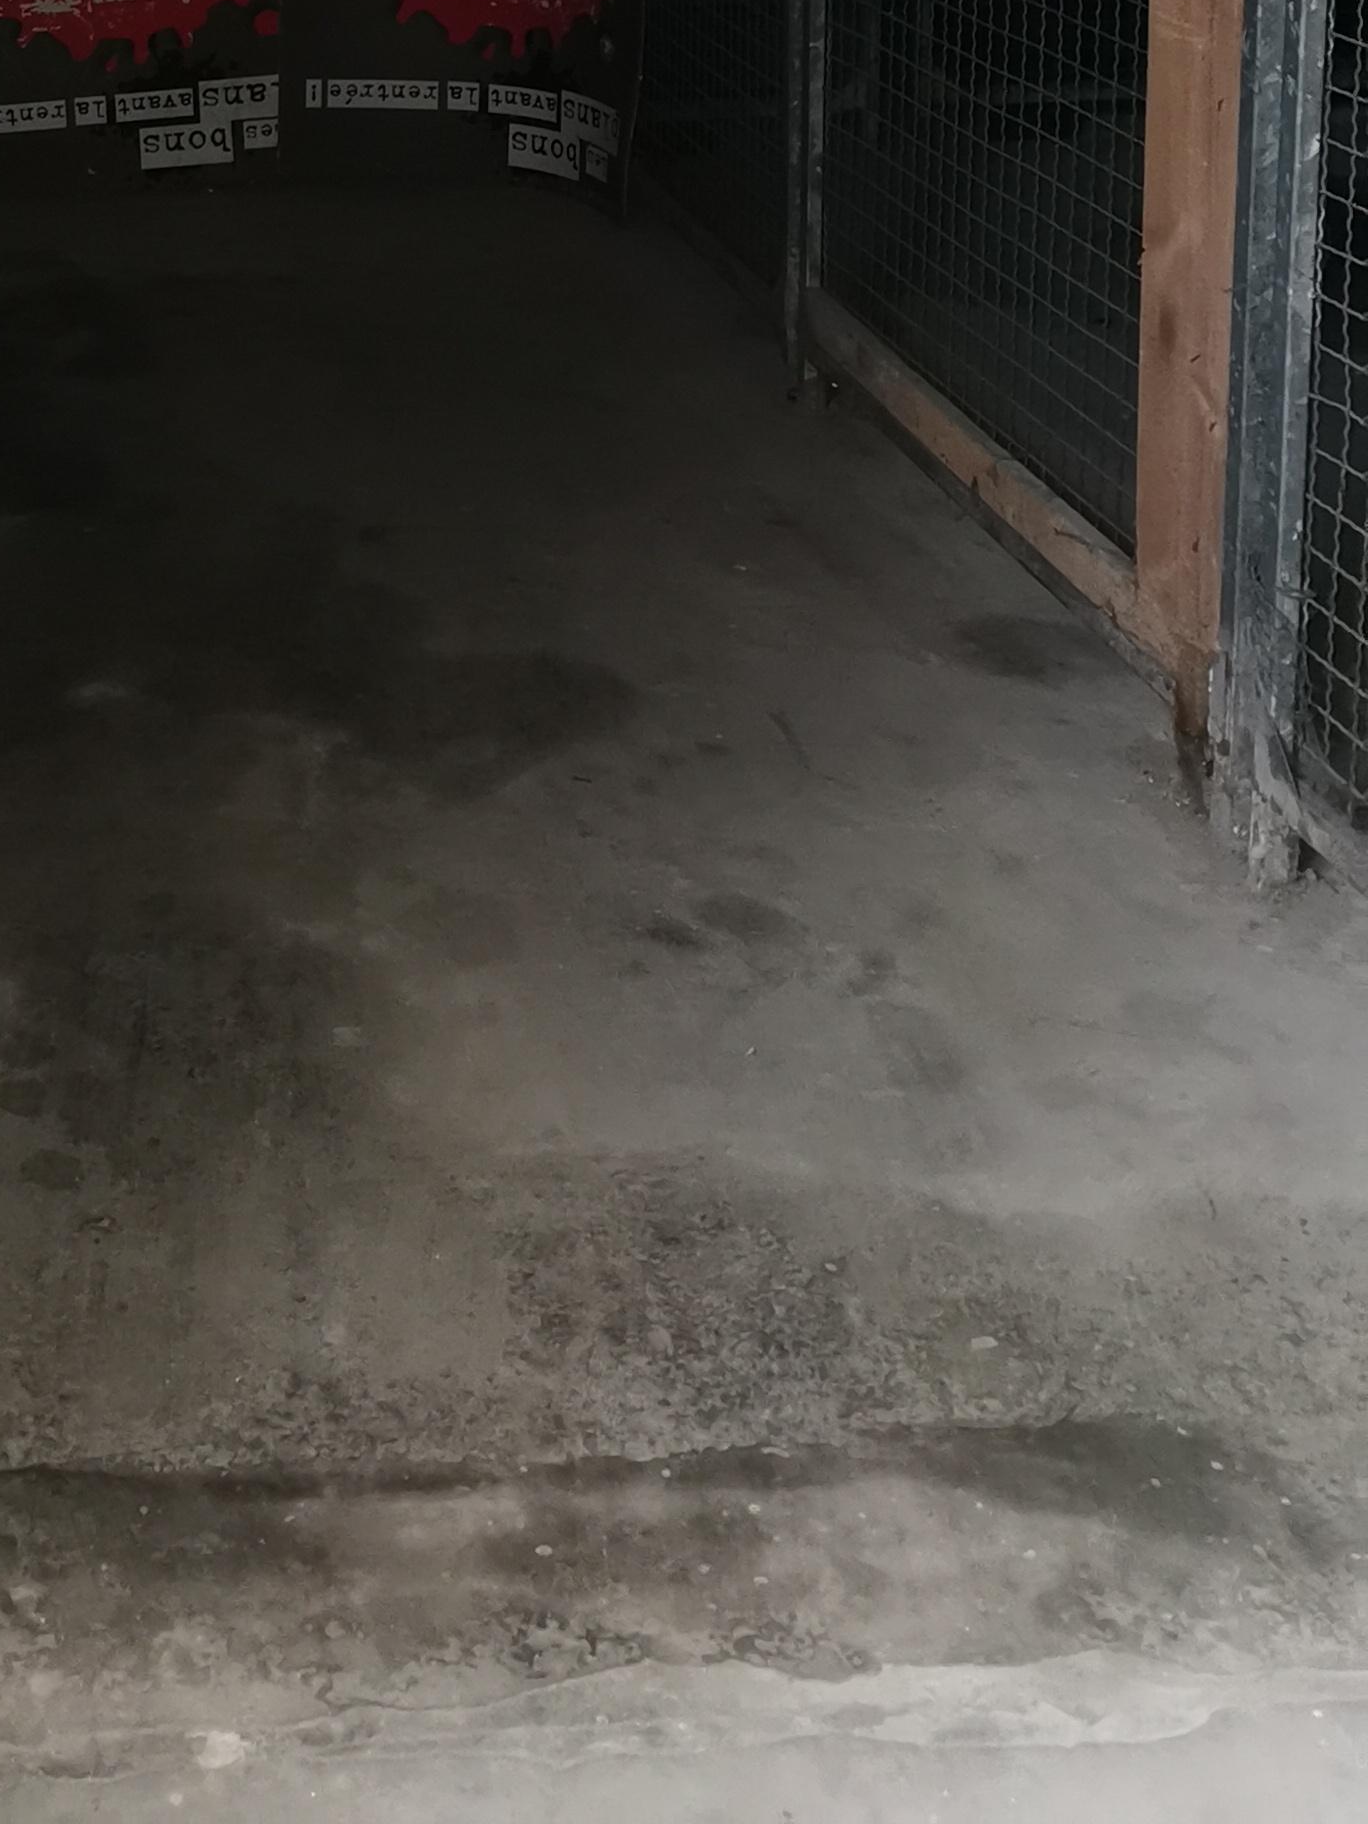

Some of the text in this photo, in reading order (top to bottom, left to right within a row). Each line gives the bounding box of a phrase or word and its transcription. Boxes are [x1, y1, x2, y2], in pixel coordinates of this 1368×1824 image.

[202, 81, 279, 106] ans
[330, 83, 437, 106] rentrée
[449, 85, 476, 100] la
[491, 88, 557, 112] avant
[75, 99, 104, 117] la
[118, 94, 192, 115] avant
[142, 122, 279, 154] es bons
[512, 131, 578, 171] bons
